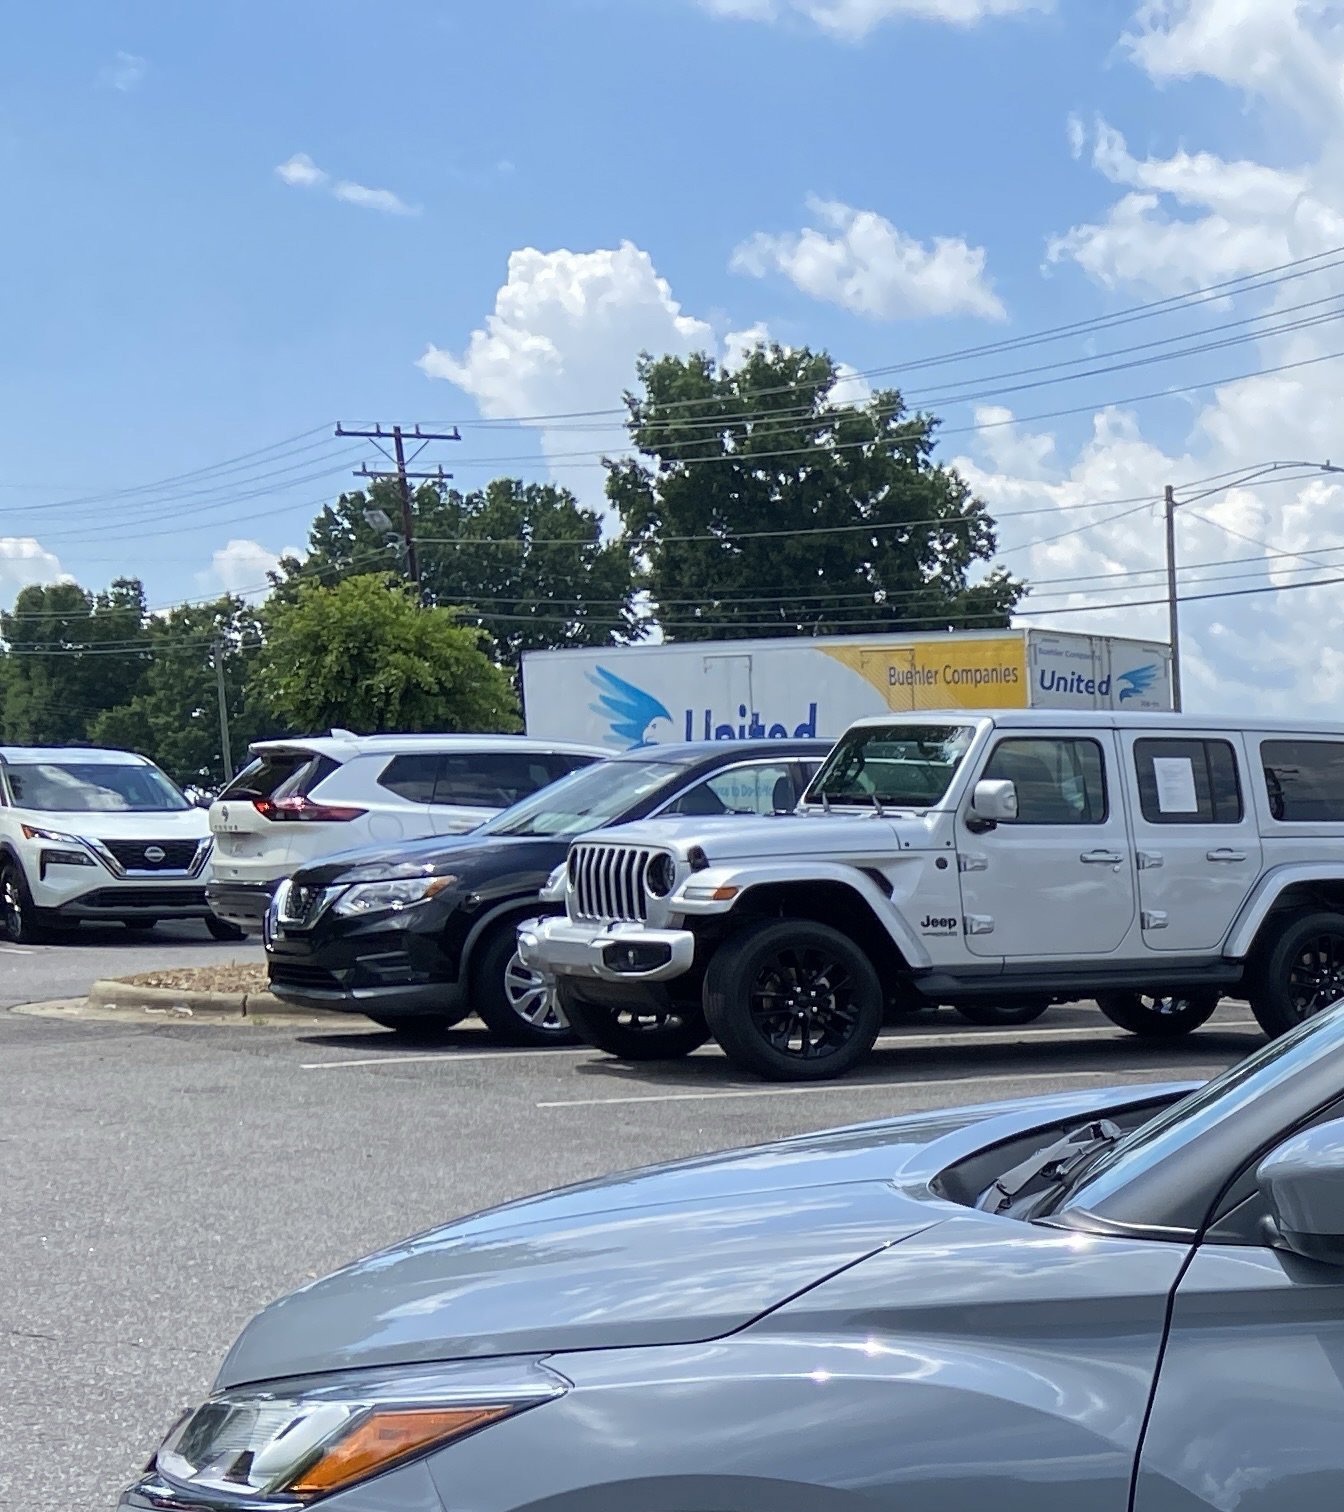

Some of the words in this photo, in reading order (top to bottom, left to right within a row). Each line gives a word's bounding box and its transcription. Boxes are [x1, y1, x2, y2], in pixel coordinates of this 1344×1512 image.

[888, 663, 939, 686] Buehler
[943, 664, 1019, 688] Companies
[1040, 668, 1111, 696] United
[920, 914, 957, 930] Jeep
